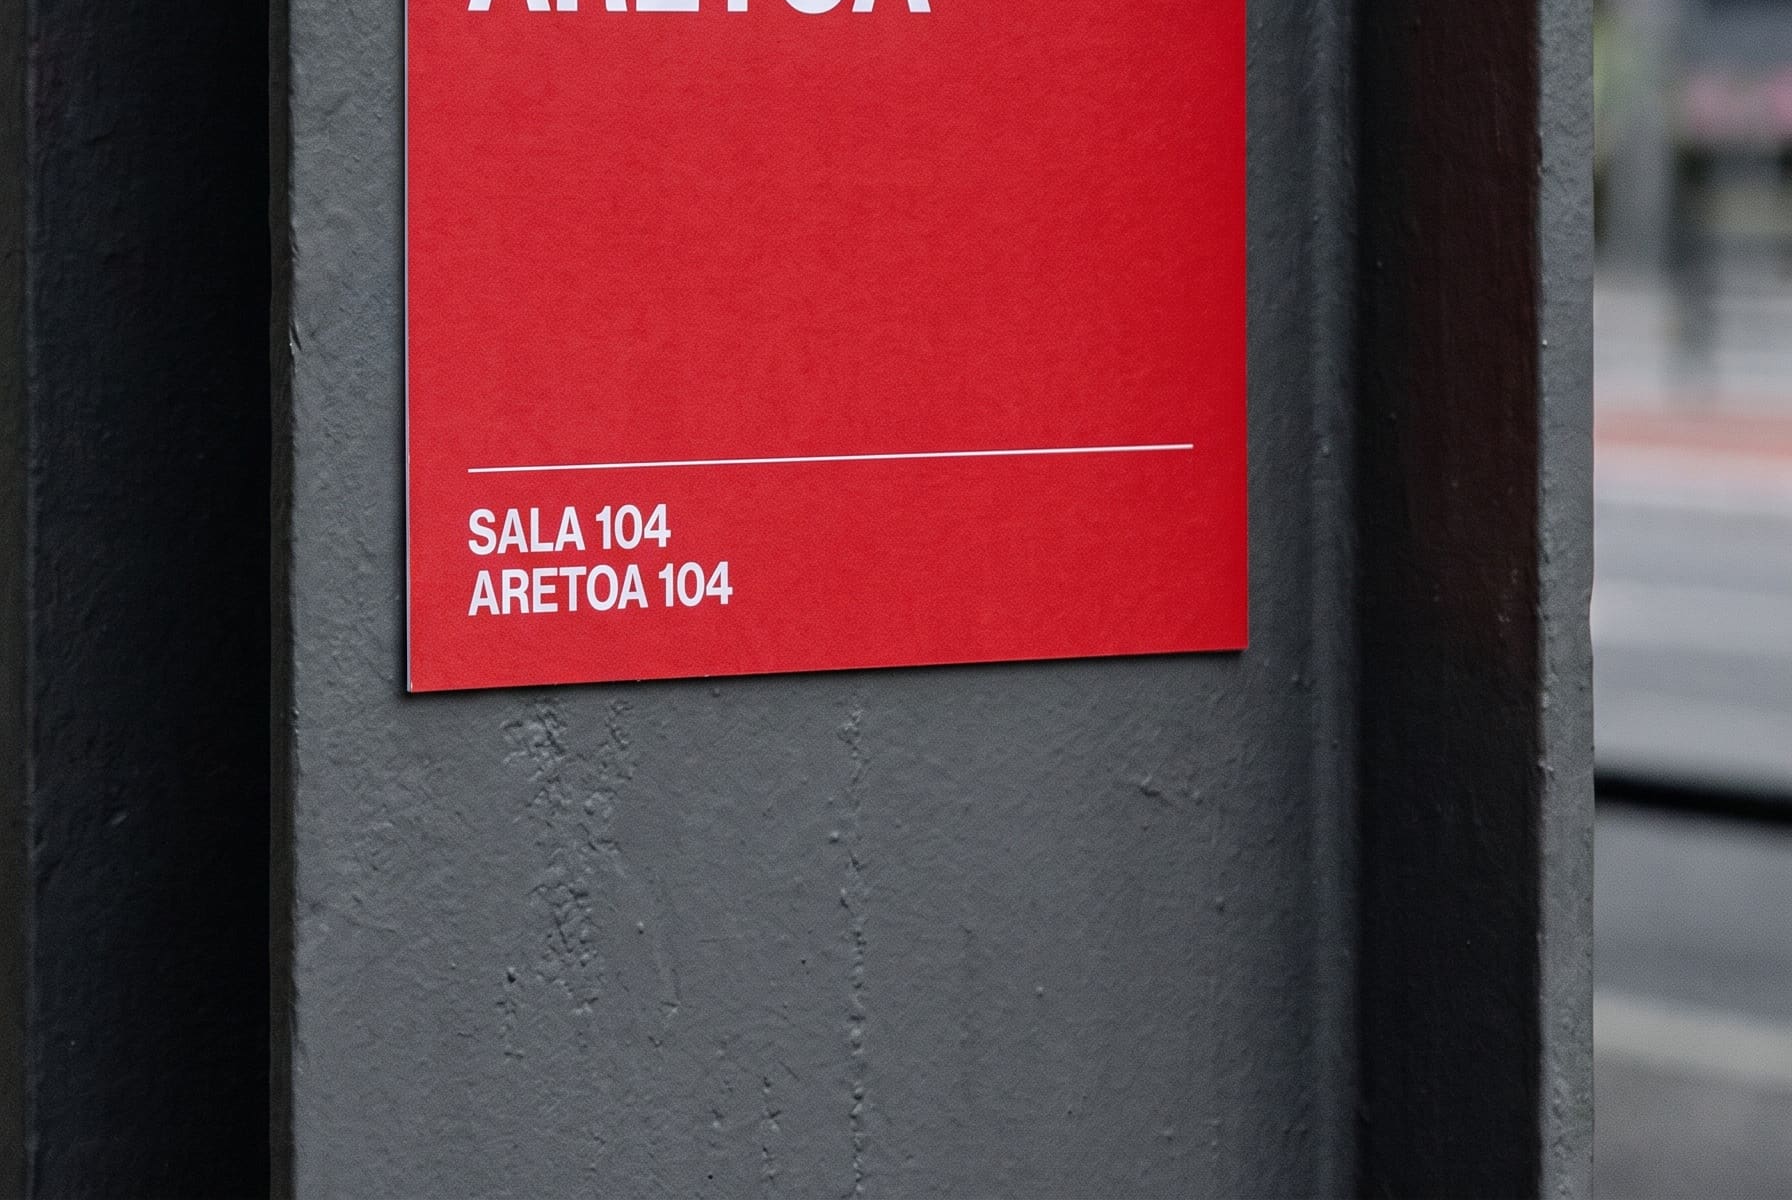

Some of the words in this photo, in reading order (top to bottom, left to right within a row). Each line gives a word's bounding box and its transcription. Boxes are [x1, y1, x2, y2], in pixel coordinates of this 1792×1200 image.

[468, 503, 585, 555] SALA
[595, 504, 671, 550] 104
[468, 563, 648, 616] ARETOA
[658, 561, 733, 608] 104
